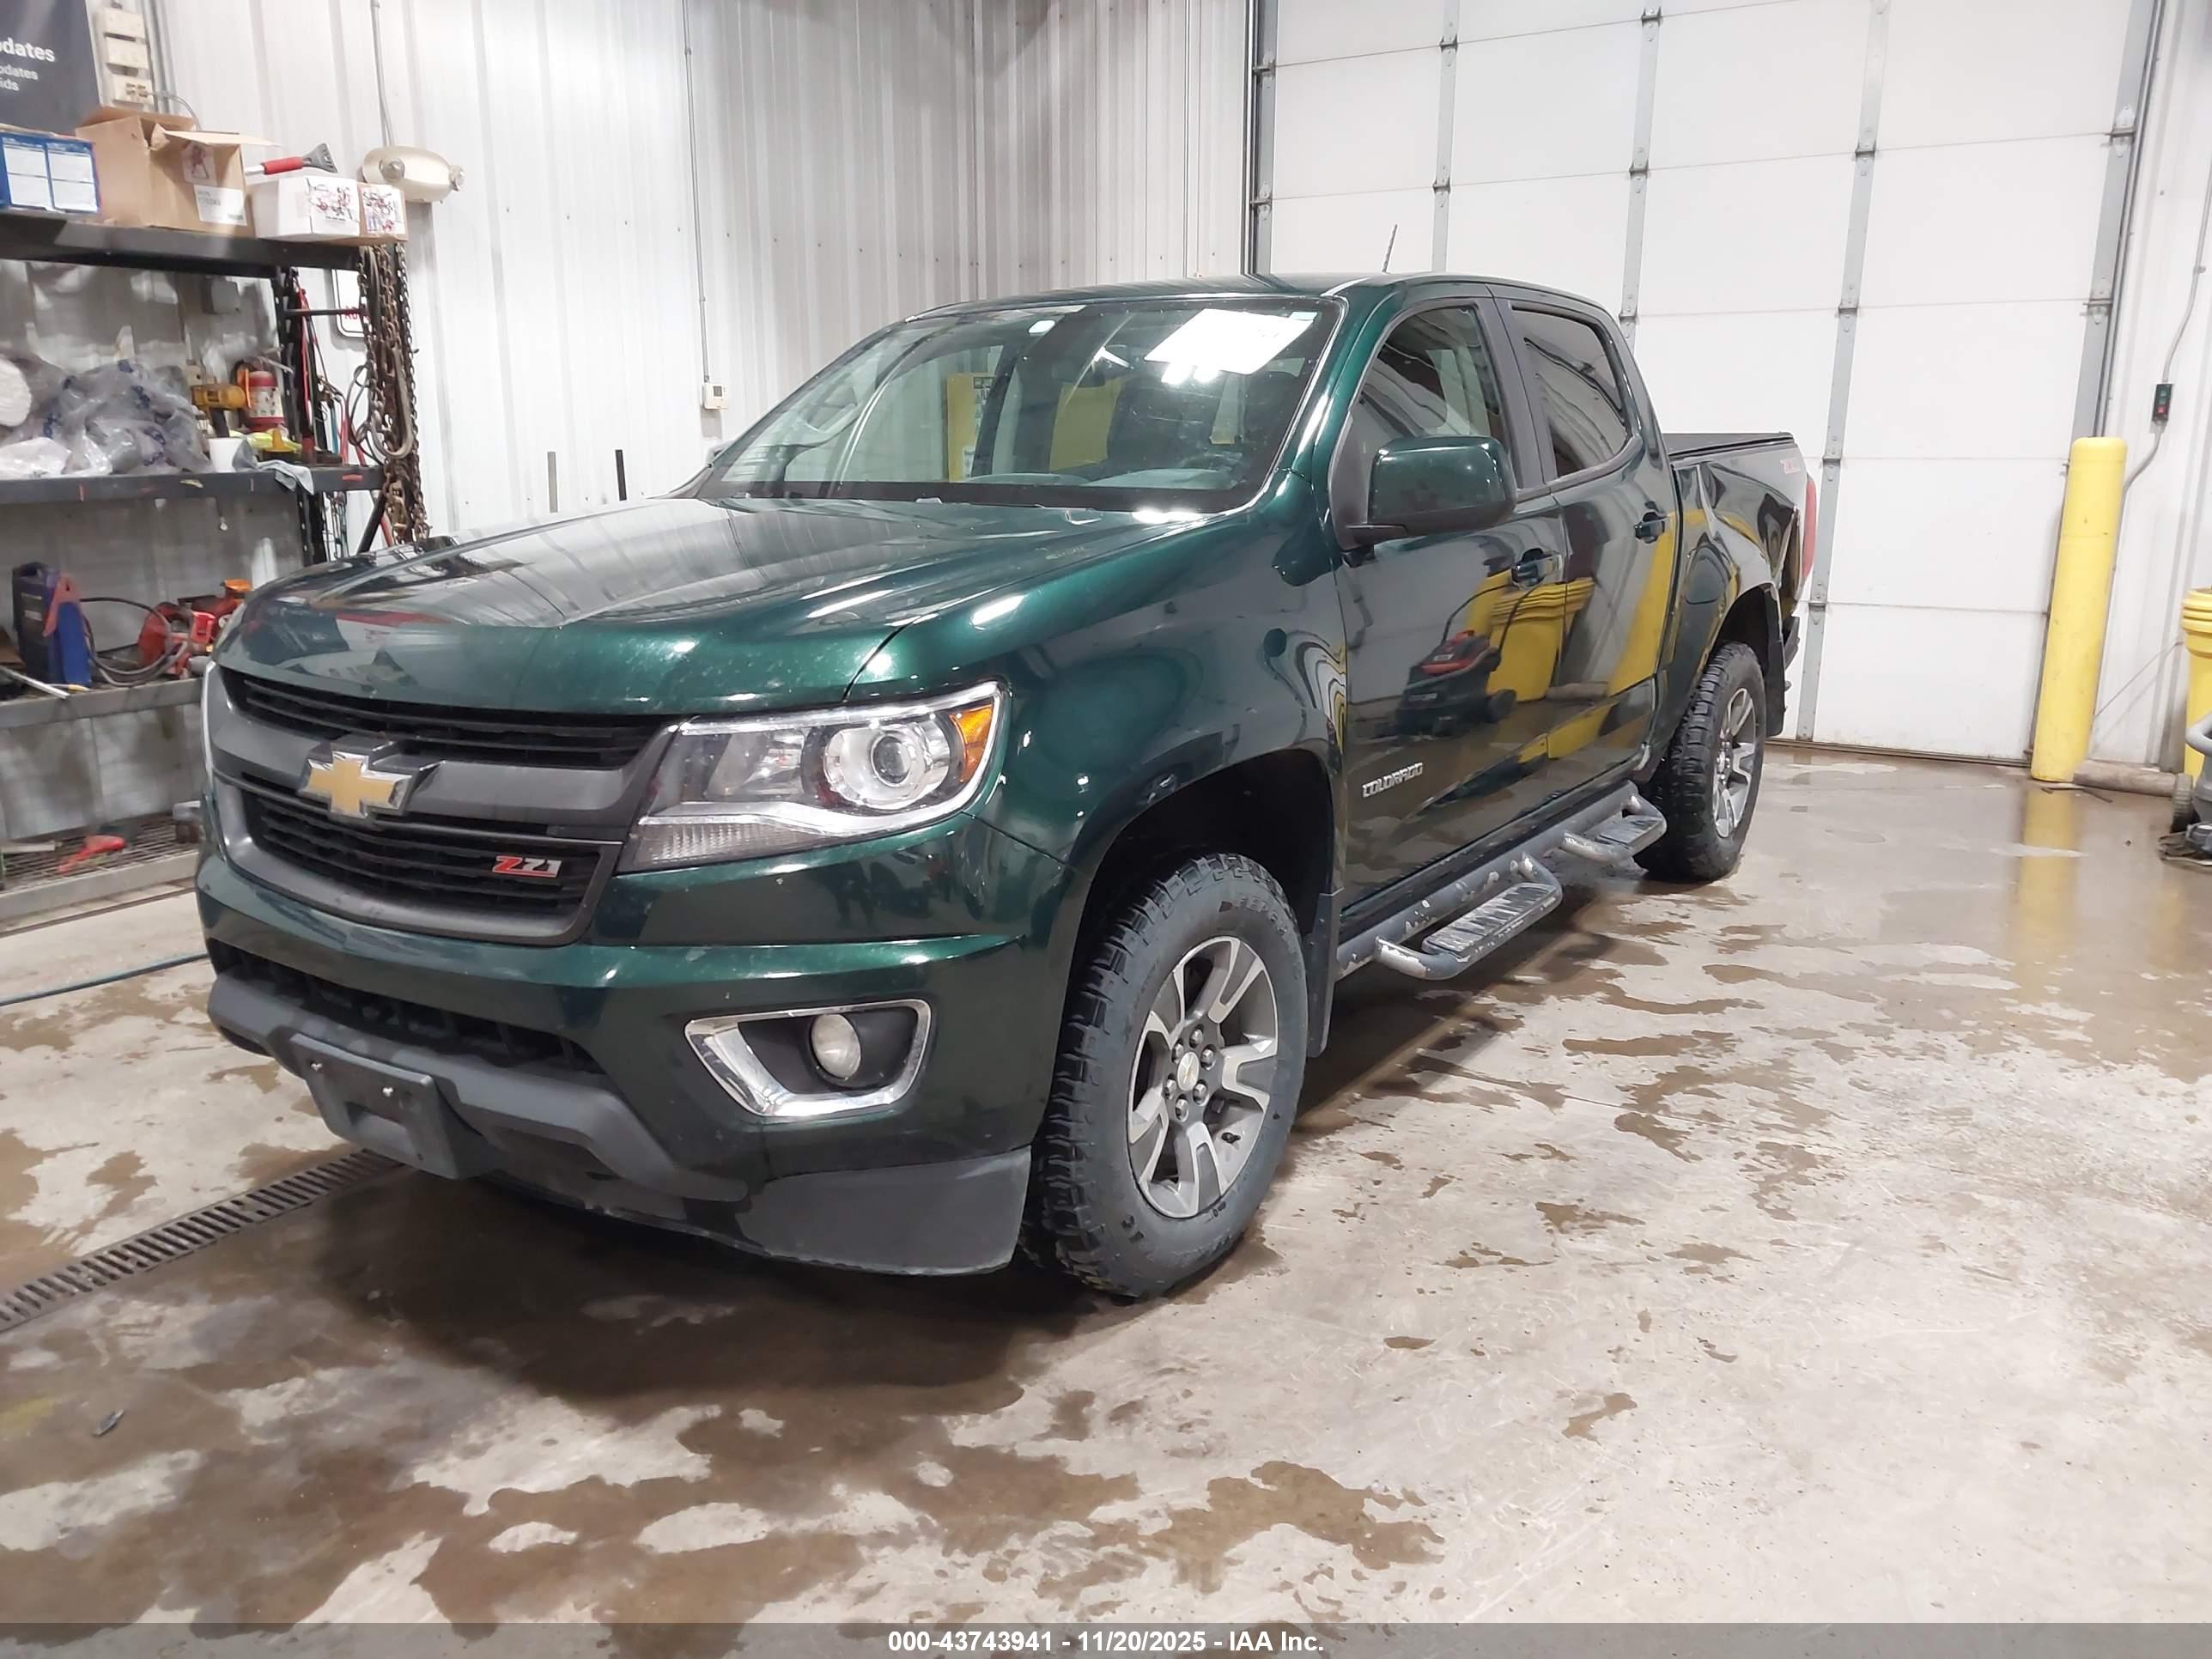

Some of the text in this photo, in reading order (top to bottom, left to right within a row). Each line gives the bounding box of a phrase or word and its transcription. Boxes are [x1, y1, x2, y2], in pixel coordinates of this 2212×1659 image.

[0, 37, 56, 62] dates
[1362, 762, 1424, 798] COLORADO
[492, 855, 562, 878] Z71
